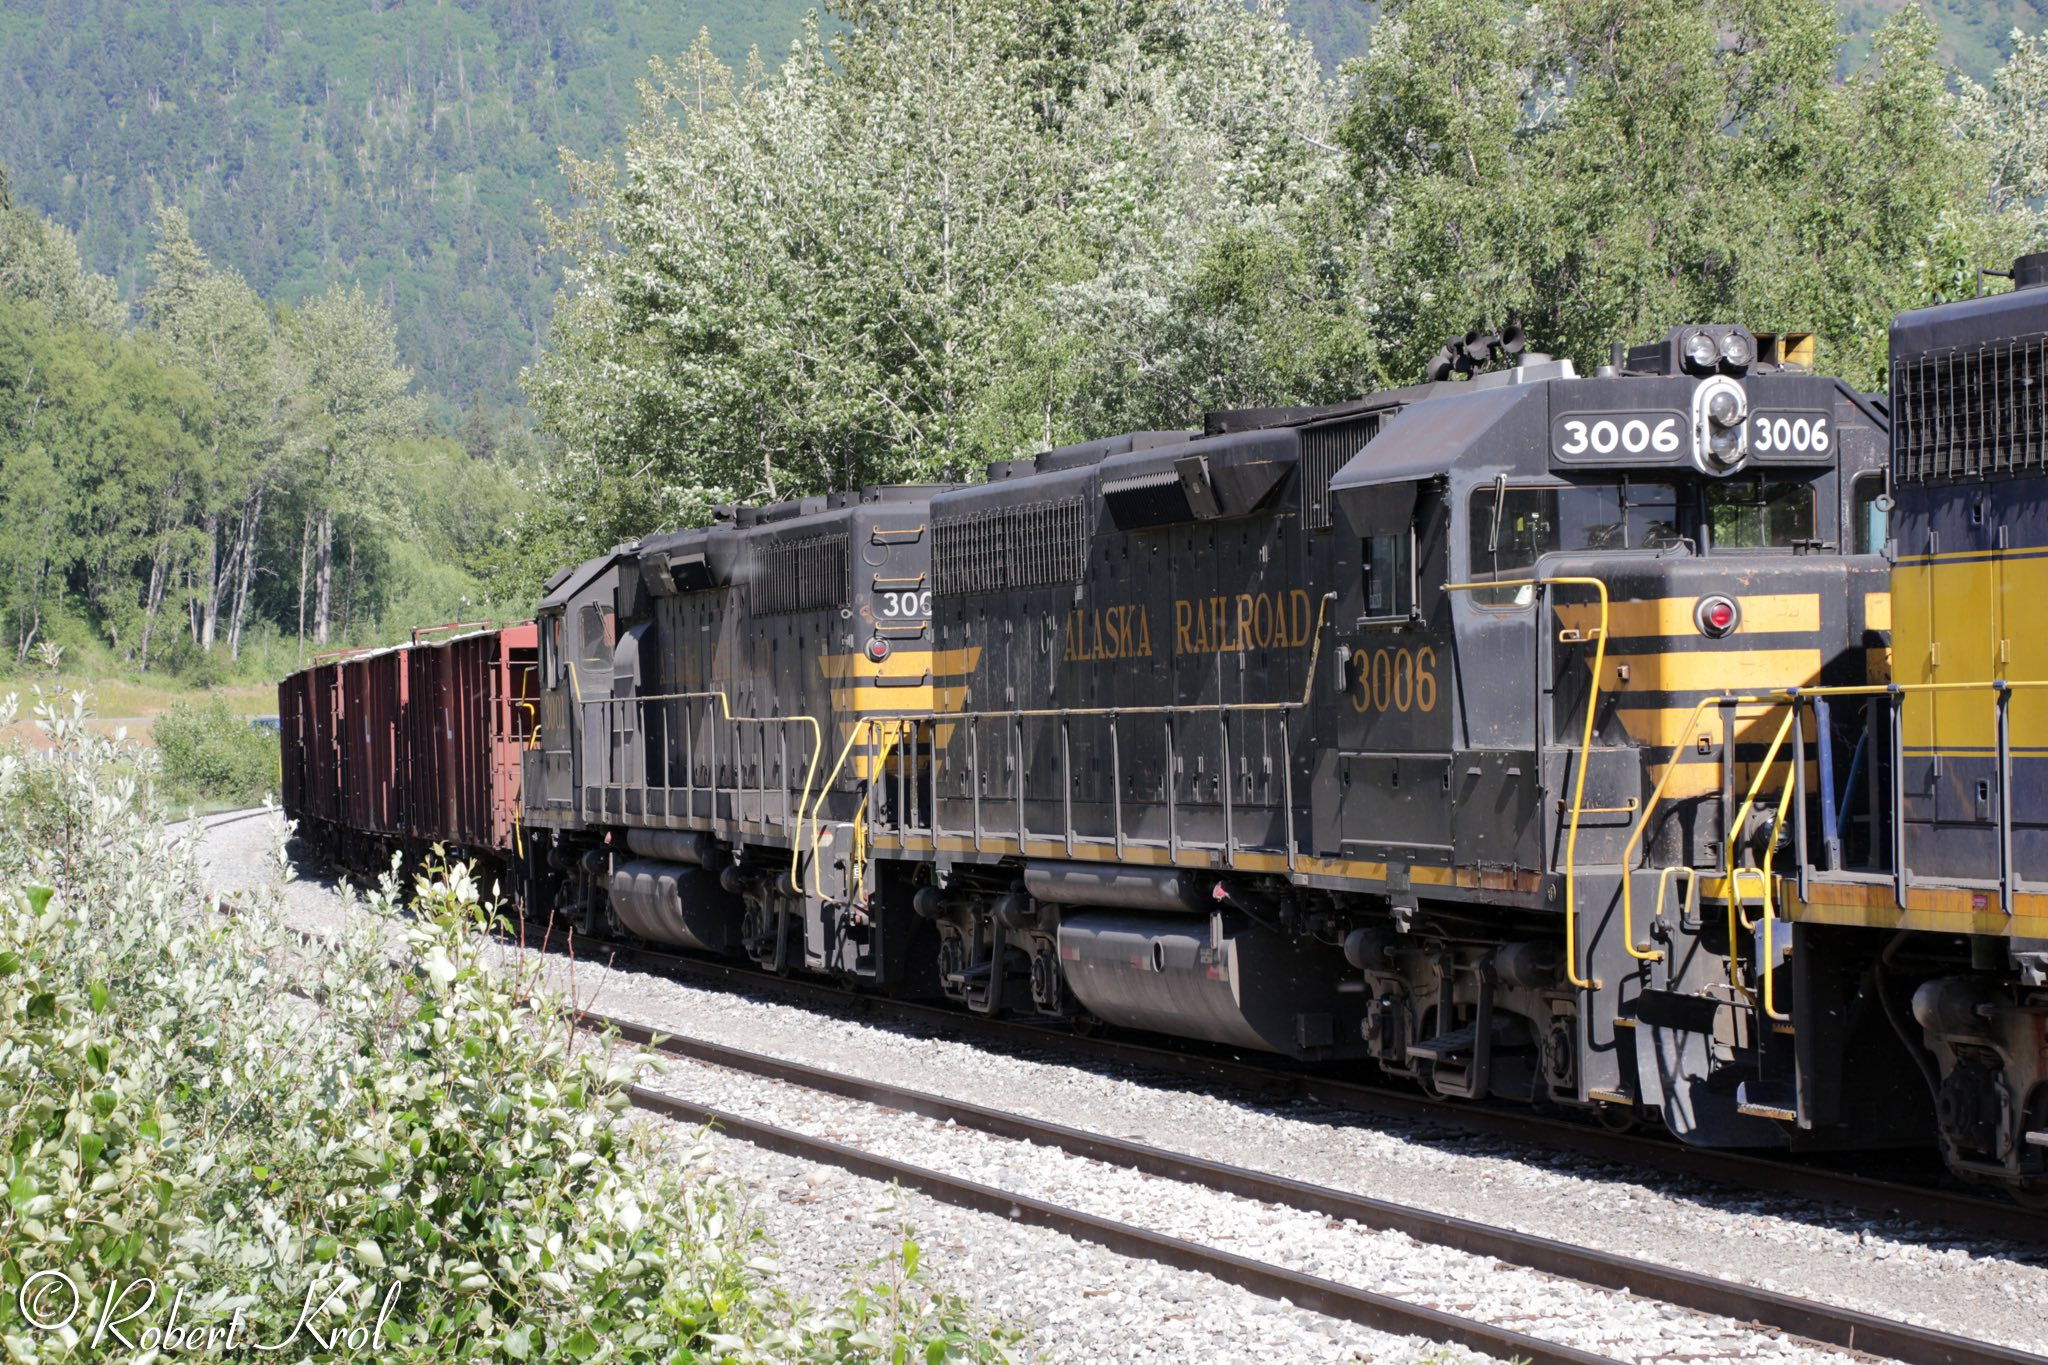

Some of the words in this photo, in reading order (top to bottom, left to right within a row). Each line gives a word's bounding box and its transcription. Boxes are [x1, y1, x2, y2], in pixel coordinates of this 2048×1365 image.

[1561, 418, 1680, 454] 3006
[1754, 417, 1830, 453] 3006
[1063, 603, 1153, 662] ALASKA
[1175, 588, 1312, 656] RAILROAD
[1351, 645, 1437, 714] 3006
[544, 694, 566, 731] 3001
